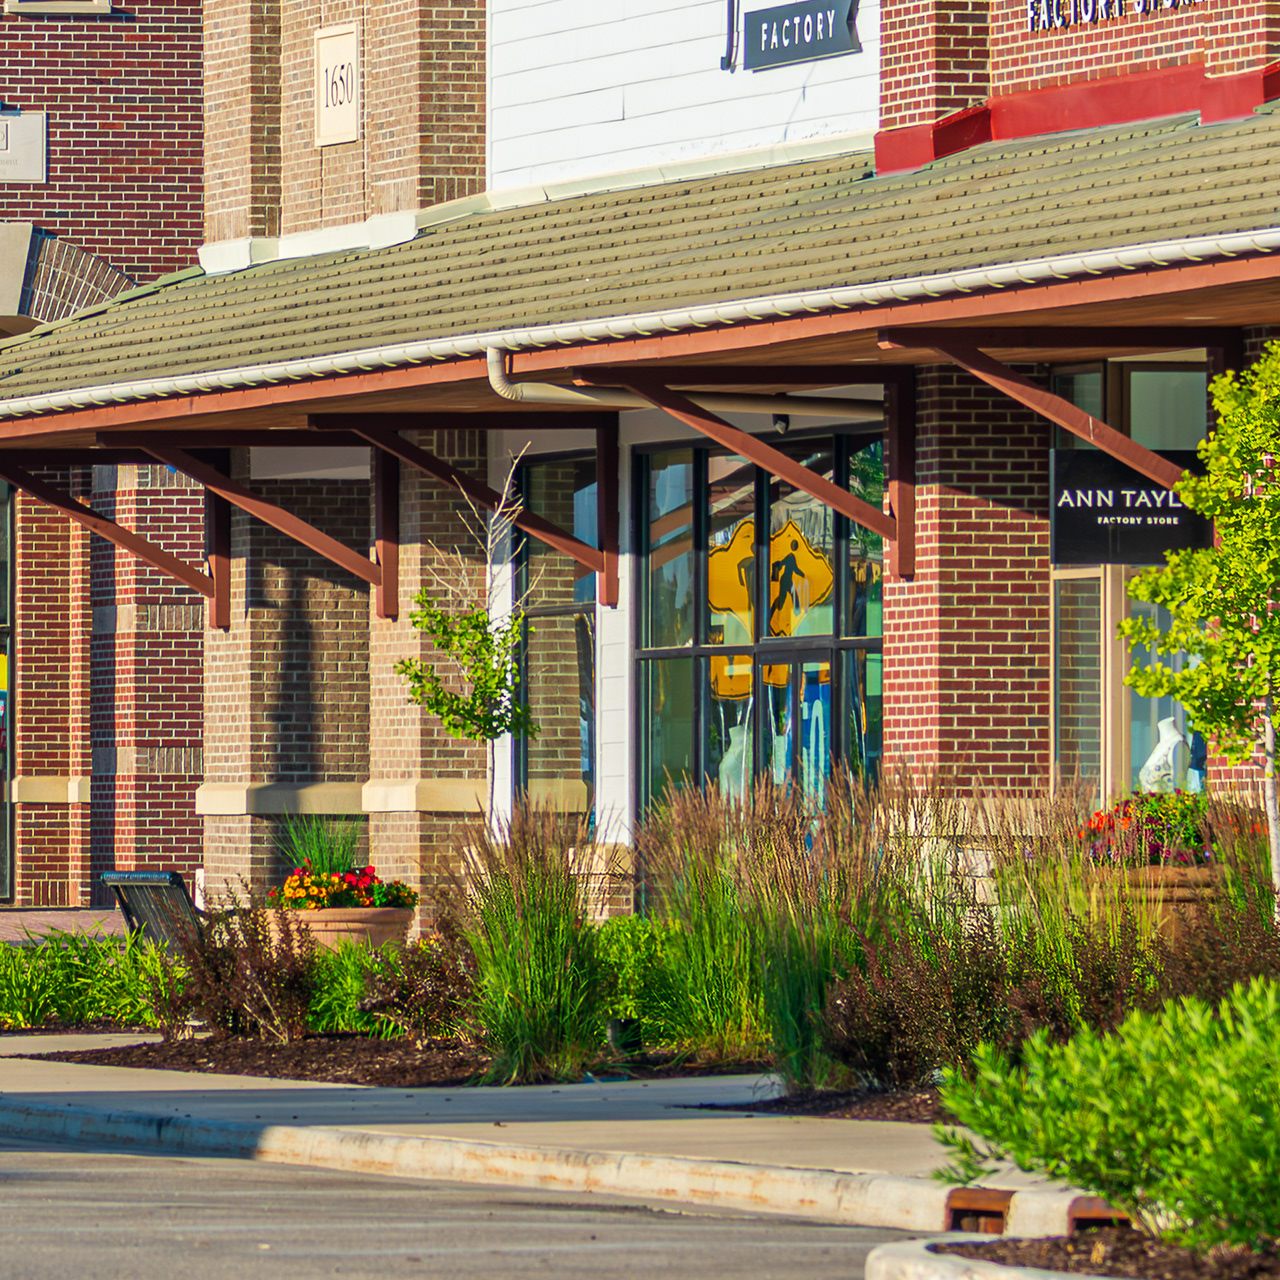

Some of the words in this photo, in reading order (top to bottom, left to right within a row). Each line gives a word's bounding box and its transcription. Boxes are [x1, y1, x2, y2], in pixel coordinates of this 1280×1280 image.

[761, 10, 836, 52] FACTORY
[324, 62, 354, 108] 1650
[1057, 489, 1114, 508] ANN
[1121, 489, 1188, 508] TAYL
[1097, 516, 1143, 525] FACTORY
[1147, 516, 1179, 525] STORE
